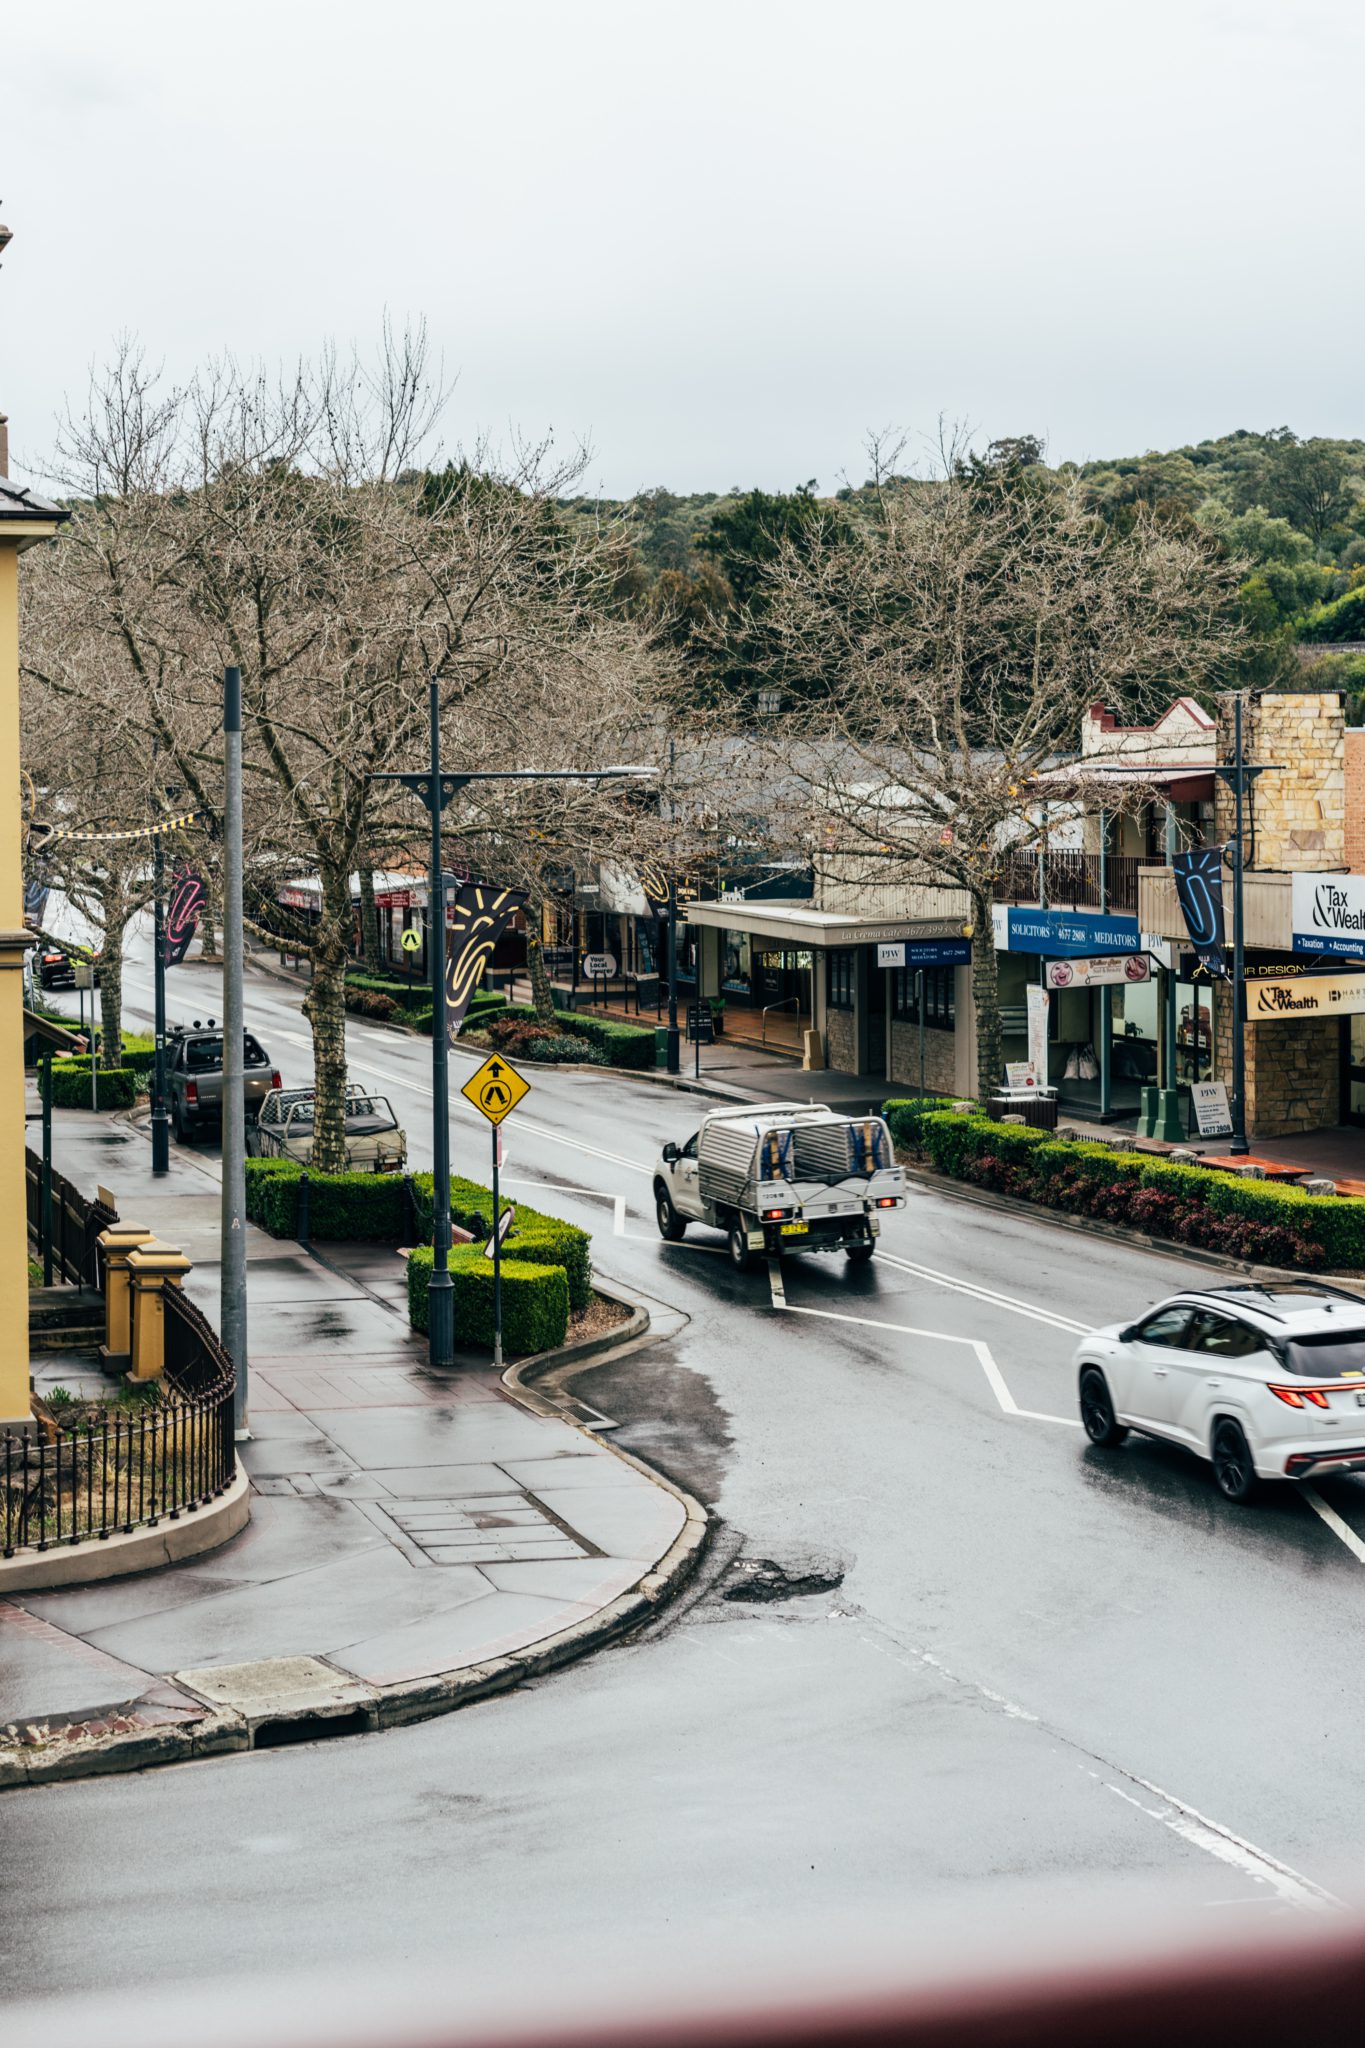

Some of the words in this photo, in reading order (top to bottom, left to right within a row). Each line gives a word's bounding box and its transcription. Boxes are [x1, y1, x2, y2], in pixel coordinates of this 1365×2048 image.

[1325, 885, 1348, 907] Tax
[841, 930, 852, 939] La
[854, 929, 881, 939] Crema
[904, 926, 925, 936] 4677
[1011, 923, 1050, 938] SOLICITORS
[1058, 928, 1071, 940] 4677
[1072, 929, 1085, 942] 2808
[1094, 932, 1136, 947] MEDIATORS
[1302, 938, 1324, 949] Taxation
[1333, 941, 1364, 955] Accounting
[881, 950, 900, 958] PJW
[1258, 965, 1304, 975] DESIGN
[1271, 987, 1292, 999] Tax
[1277, 996, 1318, 1010] Wealth
[1201, 1089, 1216, 1097] PJW
[1202, 1126, 1216, 1134] 4677
[1216, 1124, 1231, 1132] 2808
